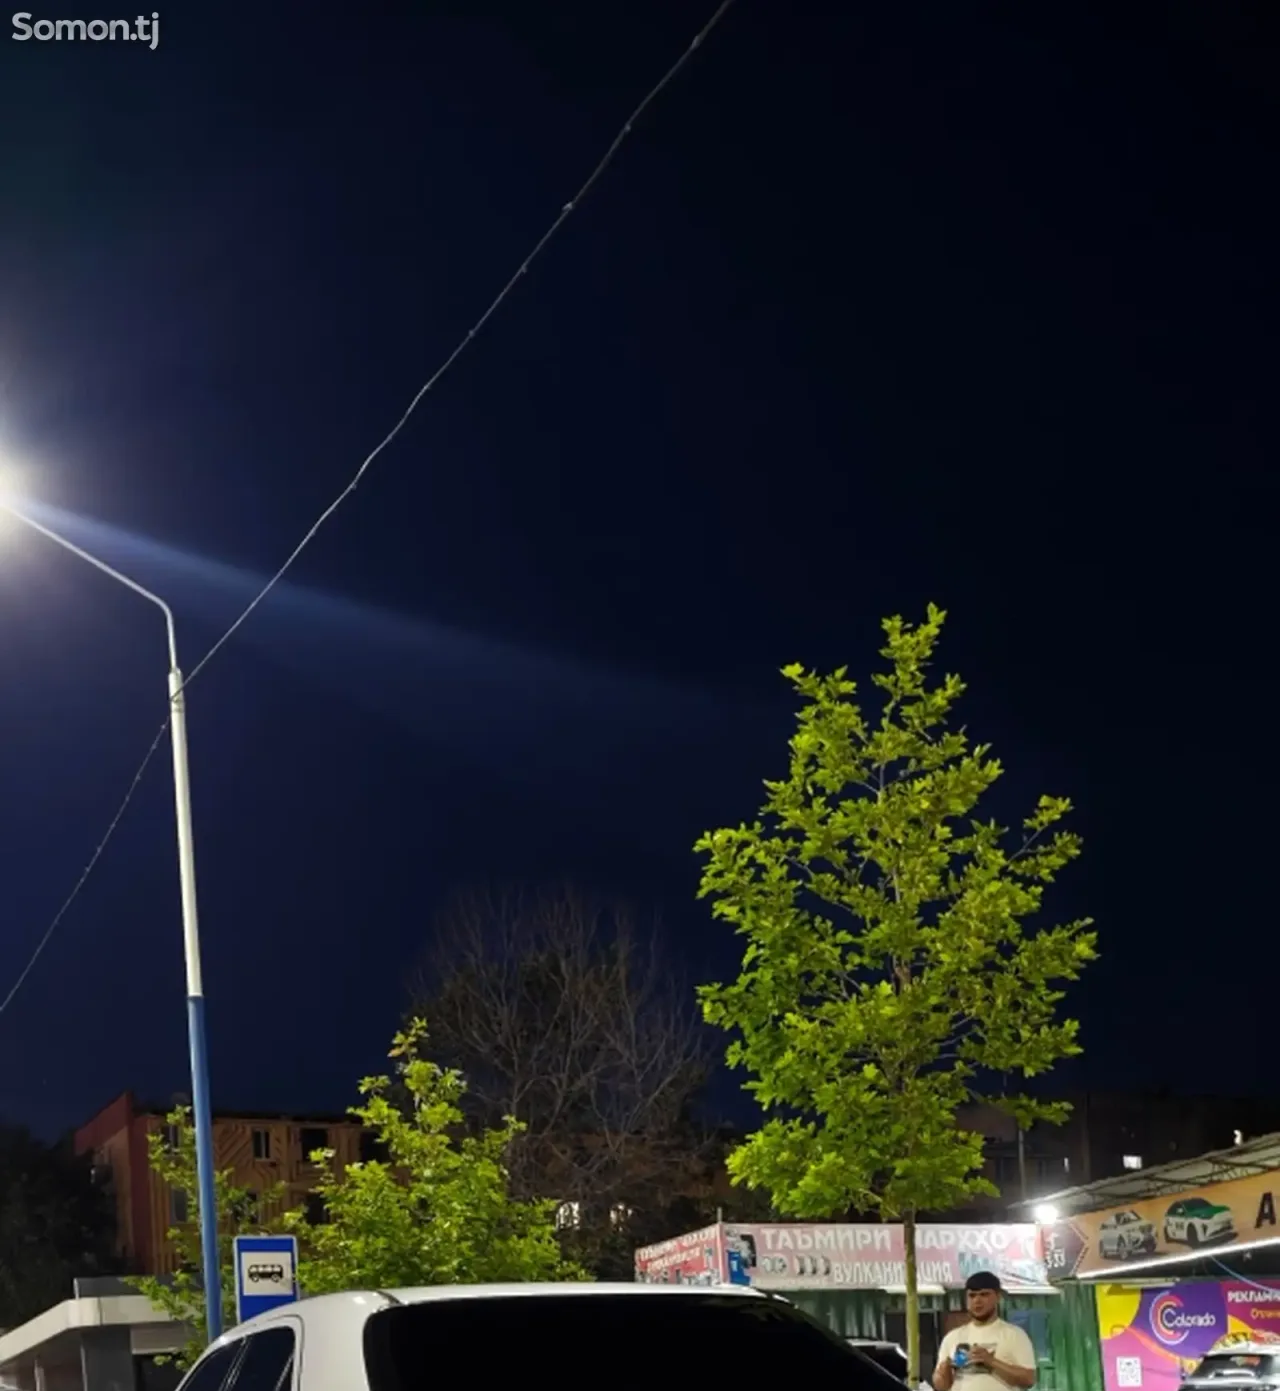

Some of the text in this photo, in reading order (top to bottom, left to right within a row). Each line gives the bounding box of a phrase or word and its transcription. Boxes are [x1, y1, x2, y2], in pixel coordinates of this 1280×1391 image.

[760, 1228, 891, 1252] ТАЪМИРИ
[833, 1260, 953, 1285] ВУЛКАНИЦИЯ
[1162, 1308, 1216, 1327] Colorado
